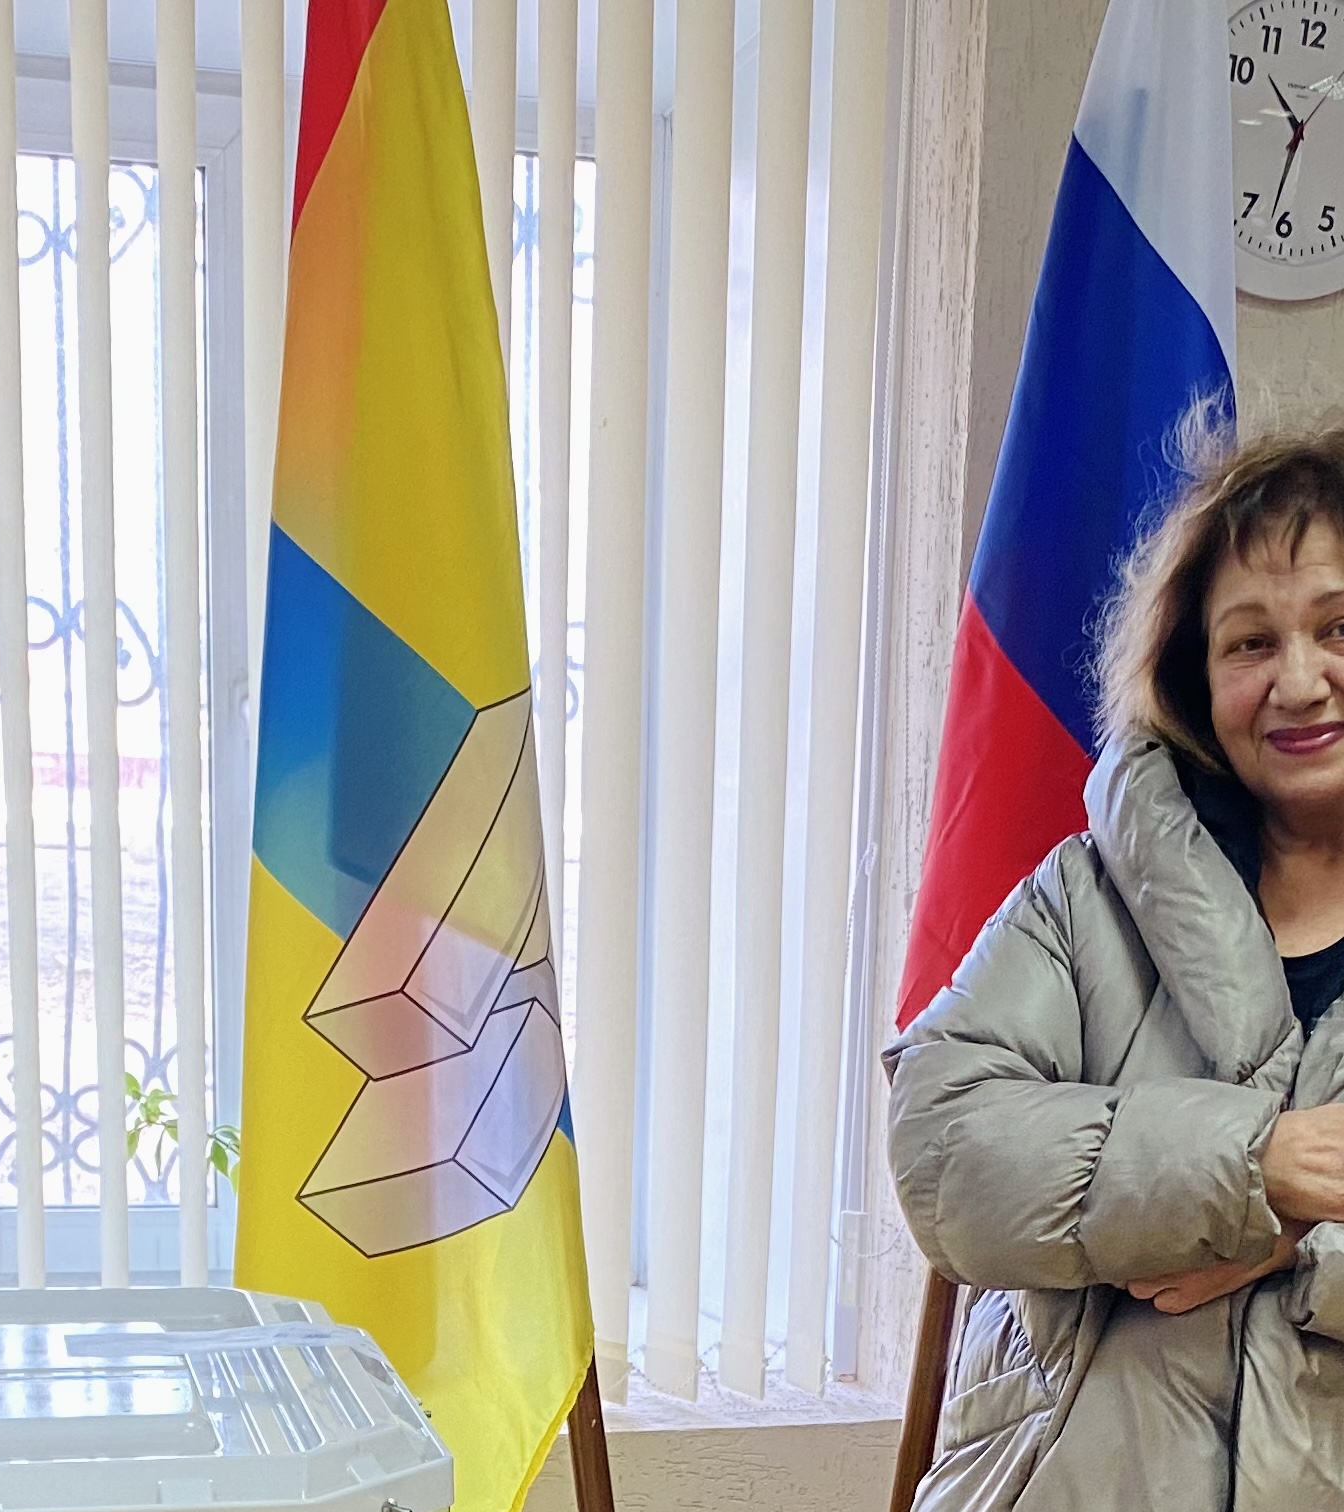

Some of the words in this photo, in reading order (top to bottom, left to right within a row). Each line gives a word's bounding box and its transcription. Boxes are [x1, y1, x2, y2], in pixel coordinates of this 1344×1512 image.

[1261, 24, 1283, 55] 11
[1300, 17, 1328, 50] 12
[1229, 53, 1255, 86] 10
[1242, 191, 1260, 219] 7
[1317, 205, 1336, 232] 5
[1275, 211, 1293, 239] 6
